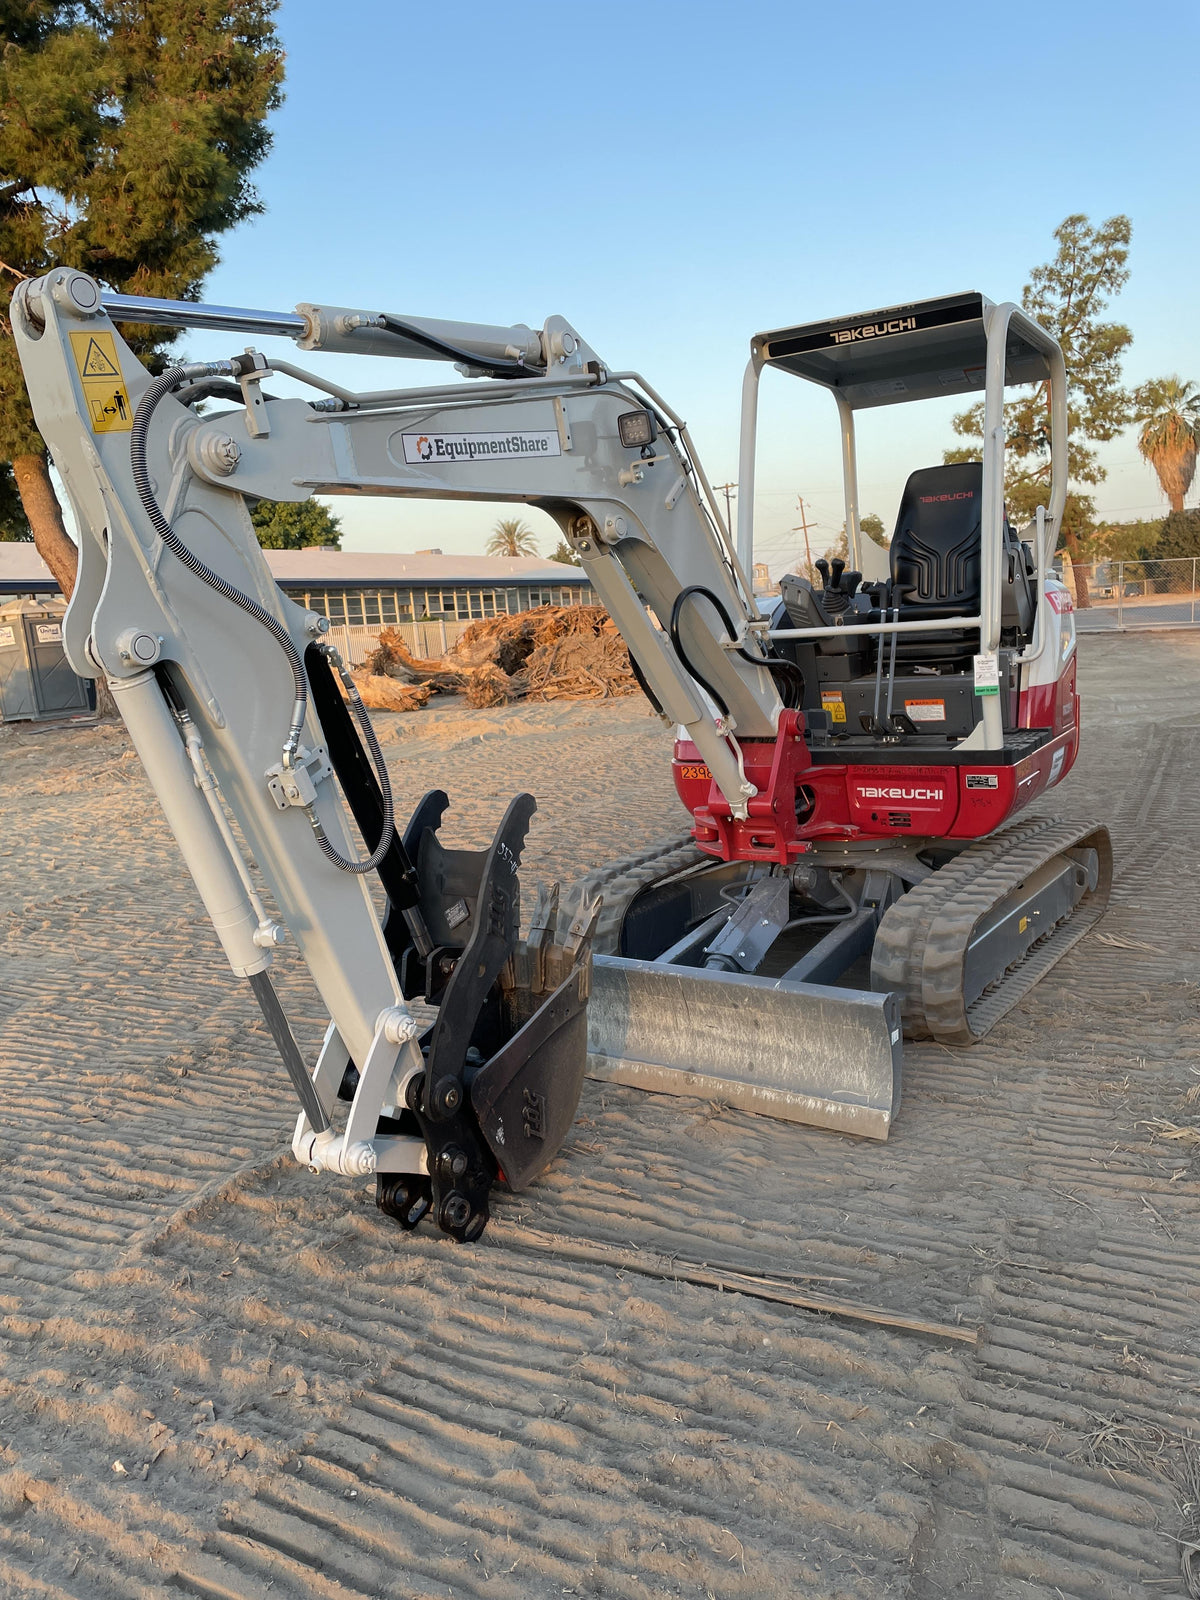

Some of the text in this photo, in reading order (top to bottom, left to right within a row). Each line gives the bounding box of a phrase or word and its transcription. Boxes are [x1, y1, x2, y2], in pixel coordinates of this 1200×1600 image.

[829, 316, 916, 344] TAKEUCHI
[434, 436, 549, 460] EquipmentShare
[856, 787, 944, 800] TAKEUCHI
